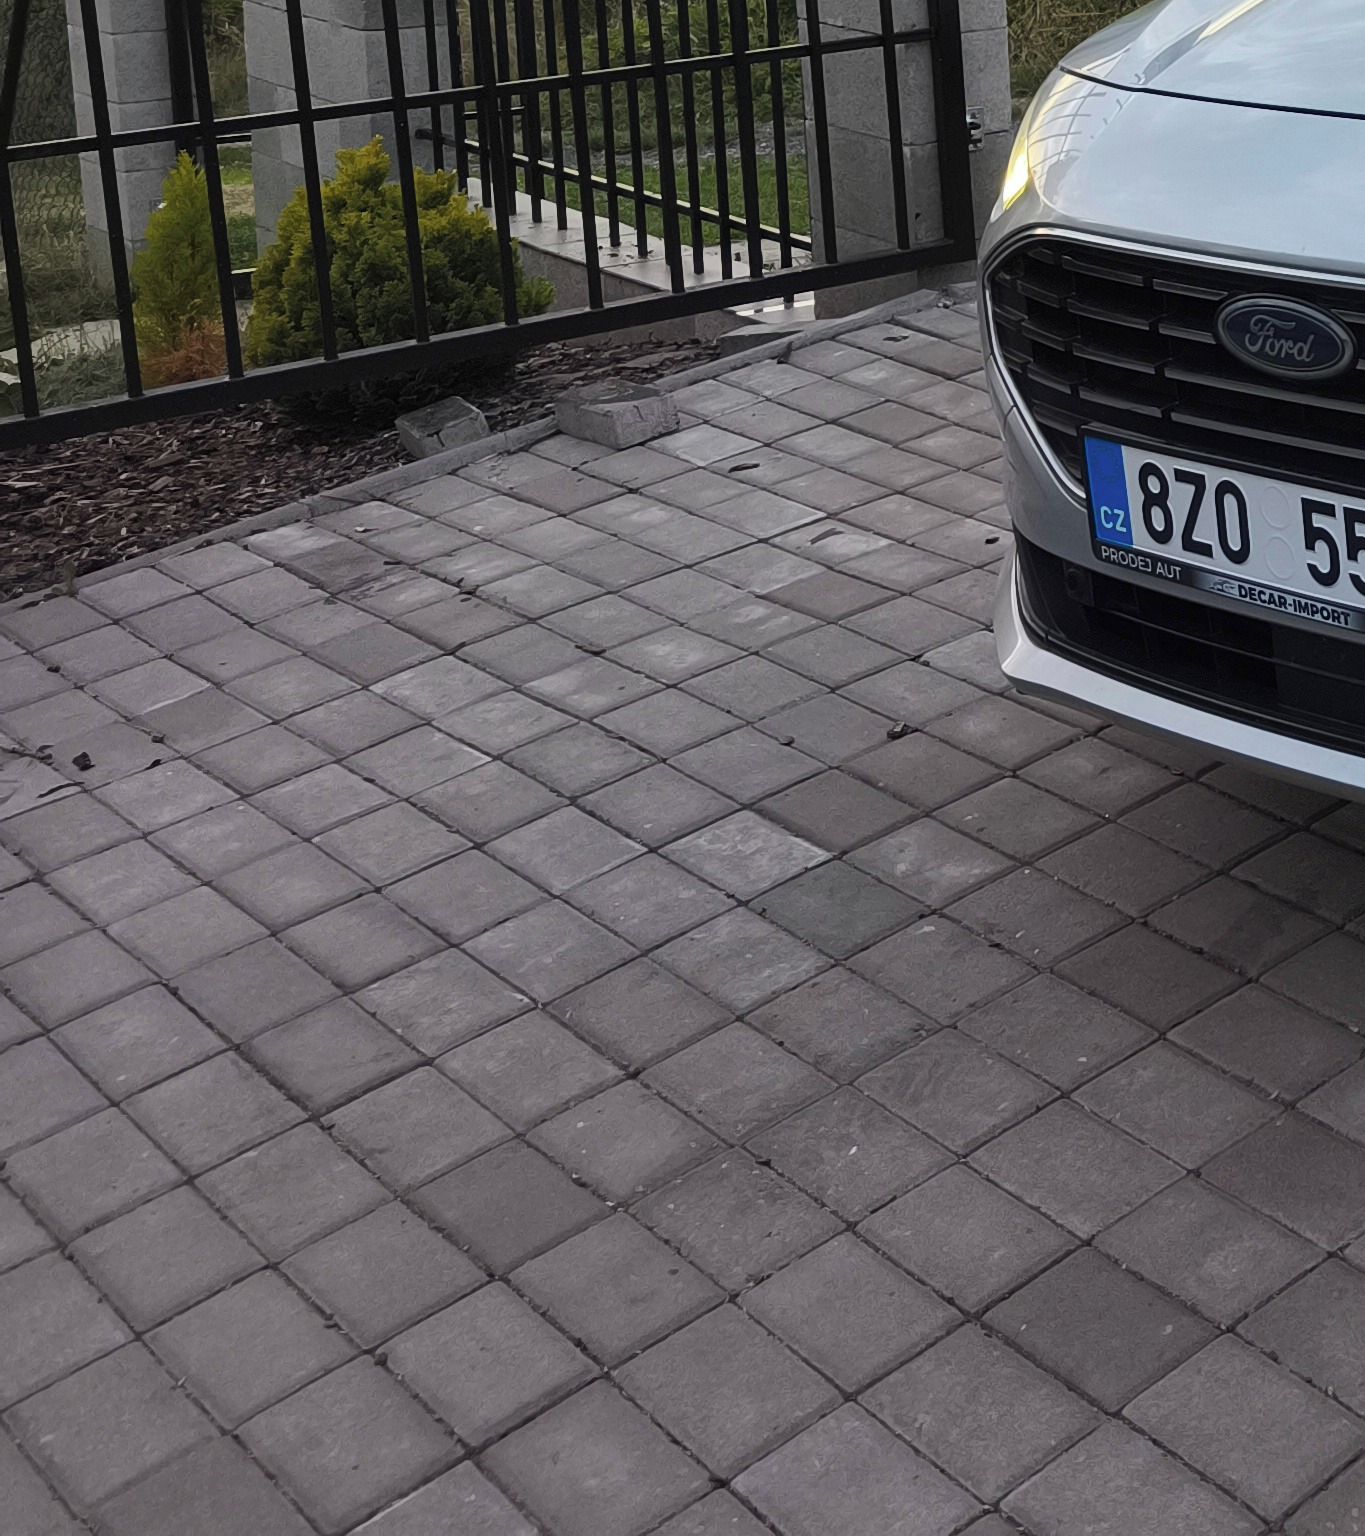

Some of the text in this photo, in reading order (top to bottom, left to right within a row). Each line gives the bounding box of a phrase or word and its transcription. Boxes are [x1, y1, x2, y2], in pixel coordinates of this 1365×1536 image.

[1245, 314, 1315, 362] Ford
[1100, 505, 1127, 533] CZ
[1138, 461, 1251, 564] 8Z0
[1101, 545, 1181, 581] PRODEJ AUT
[1237, 583, 1351, 626] DECAR-IMPORT
